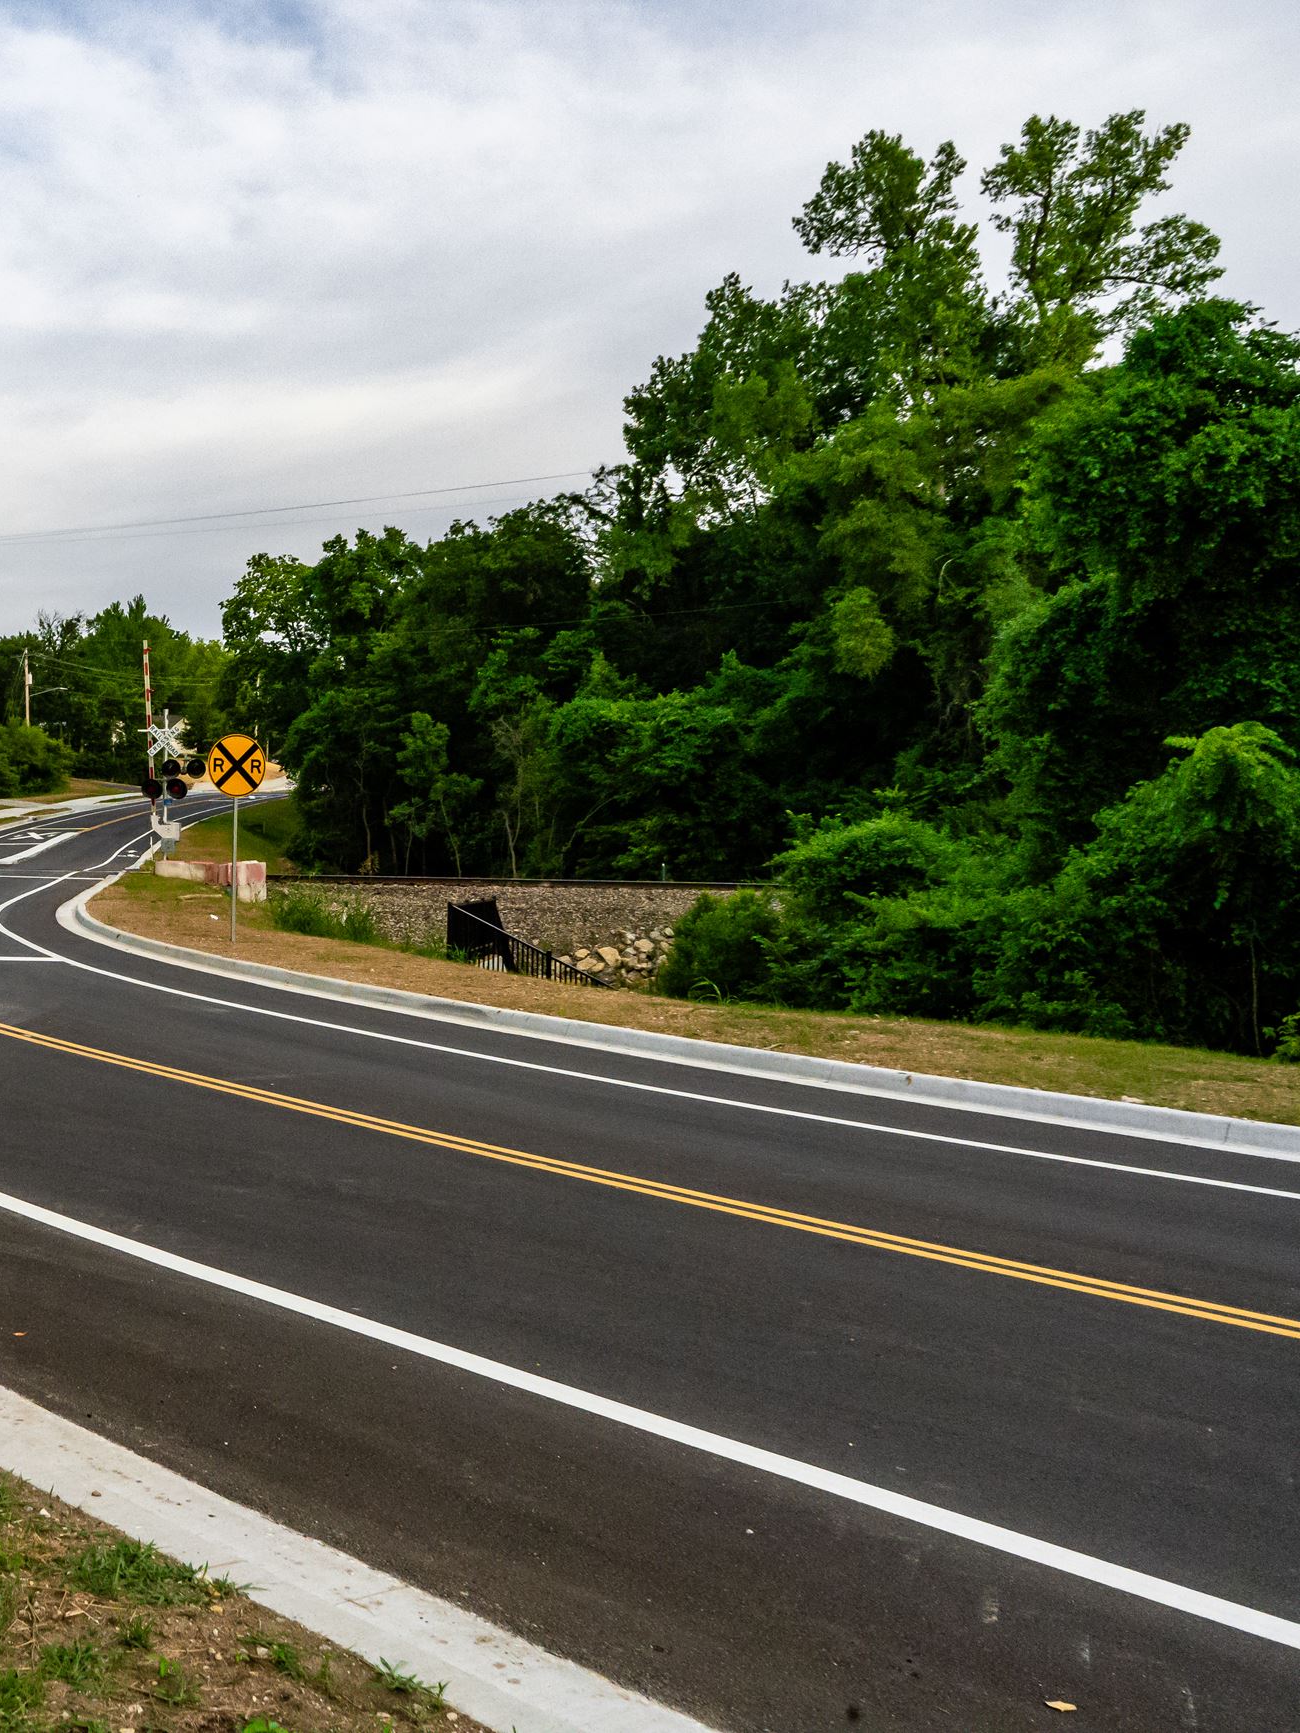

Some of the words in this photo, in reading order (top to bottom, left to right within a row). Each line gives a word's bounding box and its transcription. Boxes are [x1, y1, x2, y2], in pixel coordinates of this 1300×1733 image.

[149, 727, 179, 755] CROSSING
[213, 758, 224, 772] R
[251, 759, 261, 774] R
